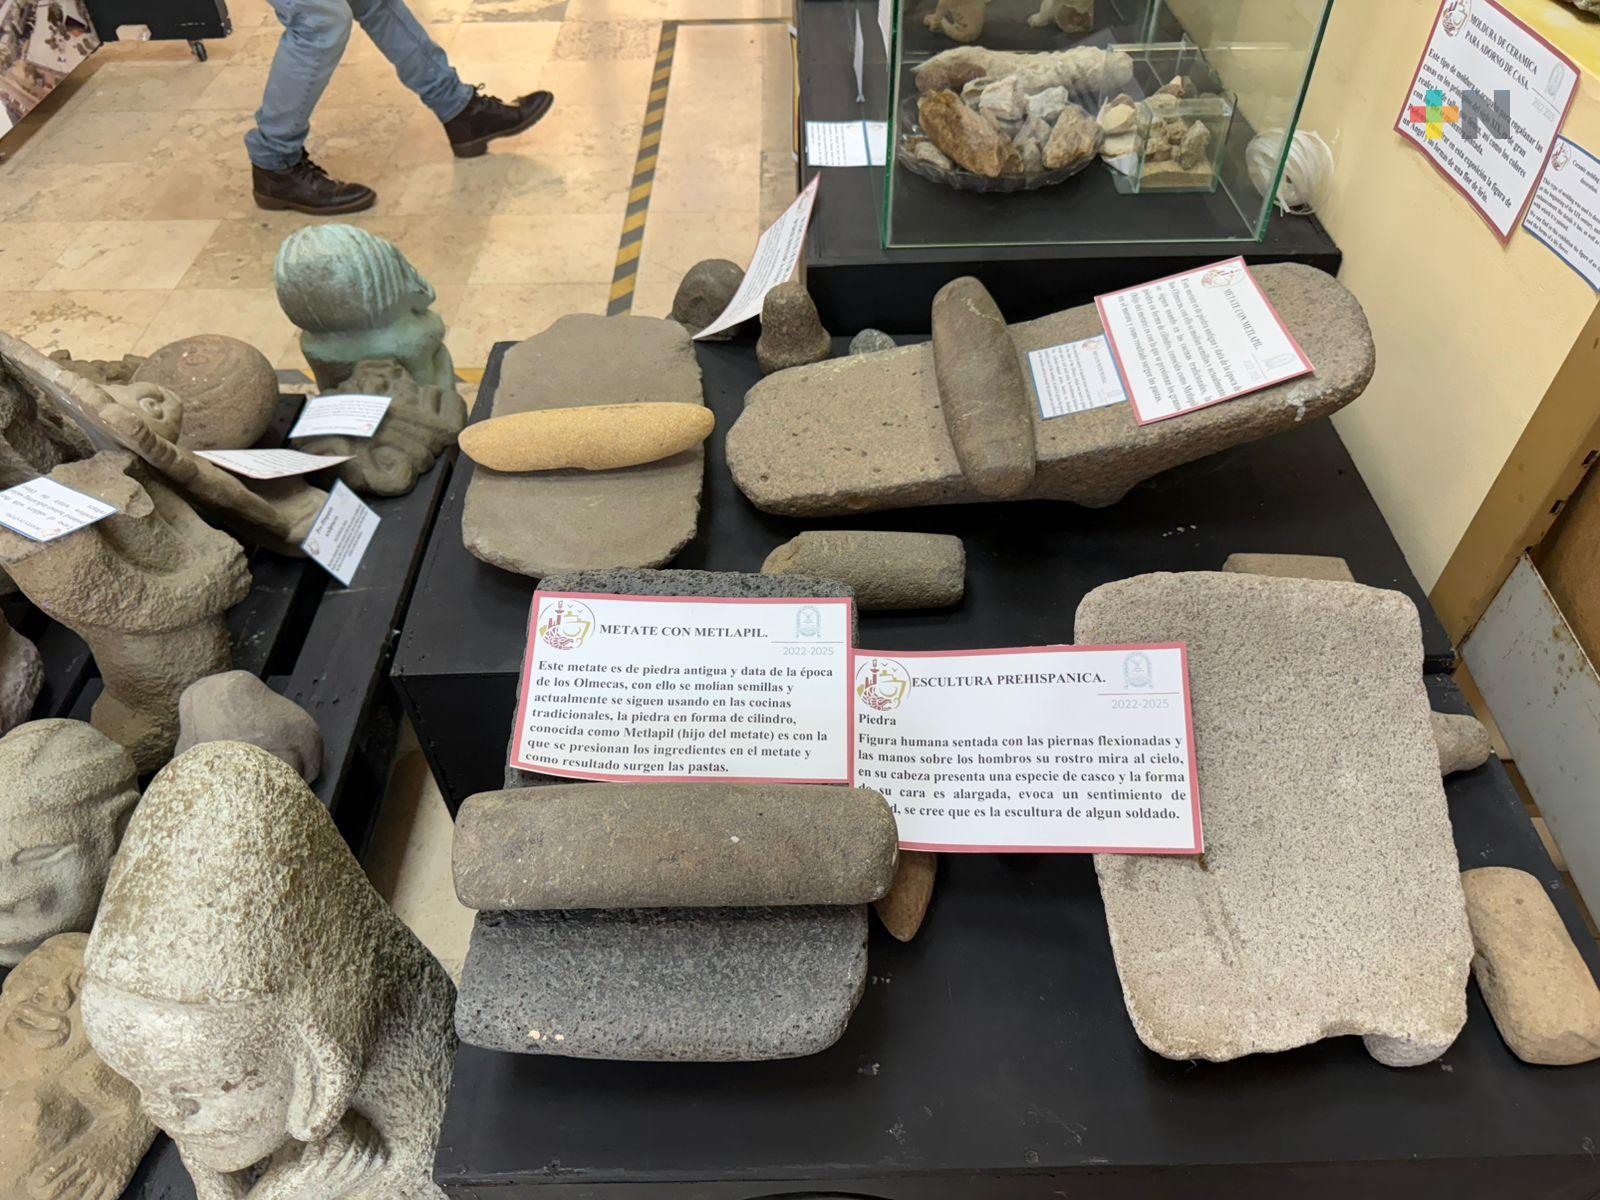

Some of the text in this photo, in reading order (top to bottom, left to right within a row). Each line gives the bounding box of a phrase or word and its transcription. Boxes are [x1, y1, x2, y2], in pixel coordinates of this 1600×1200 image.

[1464, 30, 1480, 49] PARA
[1479, 43, 1505, 68] ADORNO
[1503, 61, 1514, 76] DE
[1470, 13, 1537, 75] MOLDURA DE CERAMICA
[1422, 63, 1437, 77] casas
[1436, 73, 1444, 82] en
[1442, 75, 1451, 88] los
[1427, 47, 1440, 62] Este
[1449, 64, 1457, 75] de
[1510, 120, 1536, 145] engalanar
[1534, 139, 1543, 153] las
[1488, 138, 1526, 178] como los colores
[1447, 157, 1454, 168] de
[1453, 164, 1463, 177] una
[1470, 180, 1478, 192] de
[1454, 147, 1465, 159] esta
[1485, 176, 1492, 187] la
[1490, 182, 1506, 202] figura
[1504, 198, 1512, 208] de
[599, 624, 768, 638] METATE CON METLAPIL.
[782, 645, 834, 657] 2022-2025
[538, 660, 833, 679] Este metate es de piedra antigua y data de la época
[535, 676, 794, 695] de los Olmecas, con ello se molían semillas y
[910, 672, 1106, 688] ESCULTURA PREHISPANICA.
[534, 693, 791, 708] actualmente se siguen usando en las cocinas
[1111, 697, 1170, 710] 2022-2025
[532, 708, 796, 726] tradicionales, la piedra en forma de cilindro,
[858, 713, 896, 726] Piedra
[529, 724, 827, 742] conocida como Metlapil (hijo del metate) es con la
[858, 732, 1182, 749] Figura humana sentada con las piernas flexionadas y
[527, 739, 811, 760] que se presionan los ingredientes en el metate y
[858, 749, 1184, 765] las manos sobre los hombros su rostro mira al cielo,
[524, 753, 729, 774] como resultado surgen las pastas.
[858, 768, 1185, 785] en su cabeza presenta una especie de casco y la forma
[878, 786, 892, 797] su
[899, 788, 925, 798] cara
[933, 790, 945, 799] es
[953, 788, 1011, 802] alargada,
[1018, 790, 1054, 799] evoca
[1062, 791, 1079, 799] un
[1086, 788, 1162, 800] sentimiento
[1170, 789, 1186, 801] de
[903, 806, 916, 815] se
[919, 807, 945, 816] cree
[947, 808, 970, 820] que
[973, 808, 986, 817] es
[989, 806, 1001, 817] la
[1004, 806, 1063, 818] escultura
[1066, 806, 1081, 818] de
[1085, 806, 1121, 821] algun
[1125, 807, 1180, 819] soldado.
